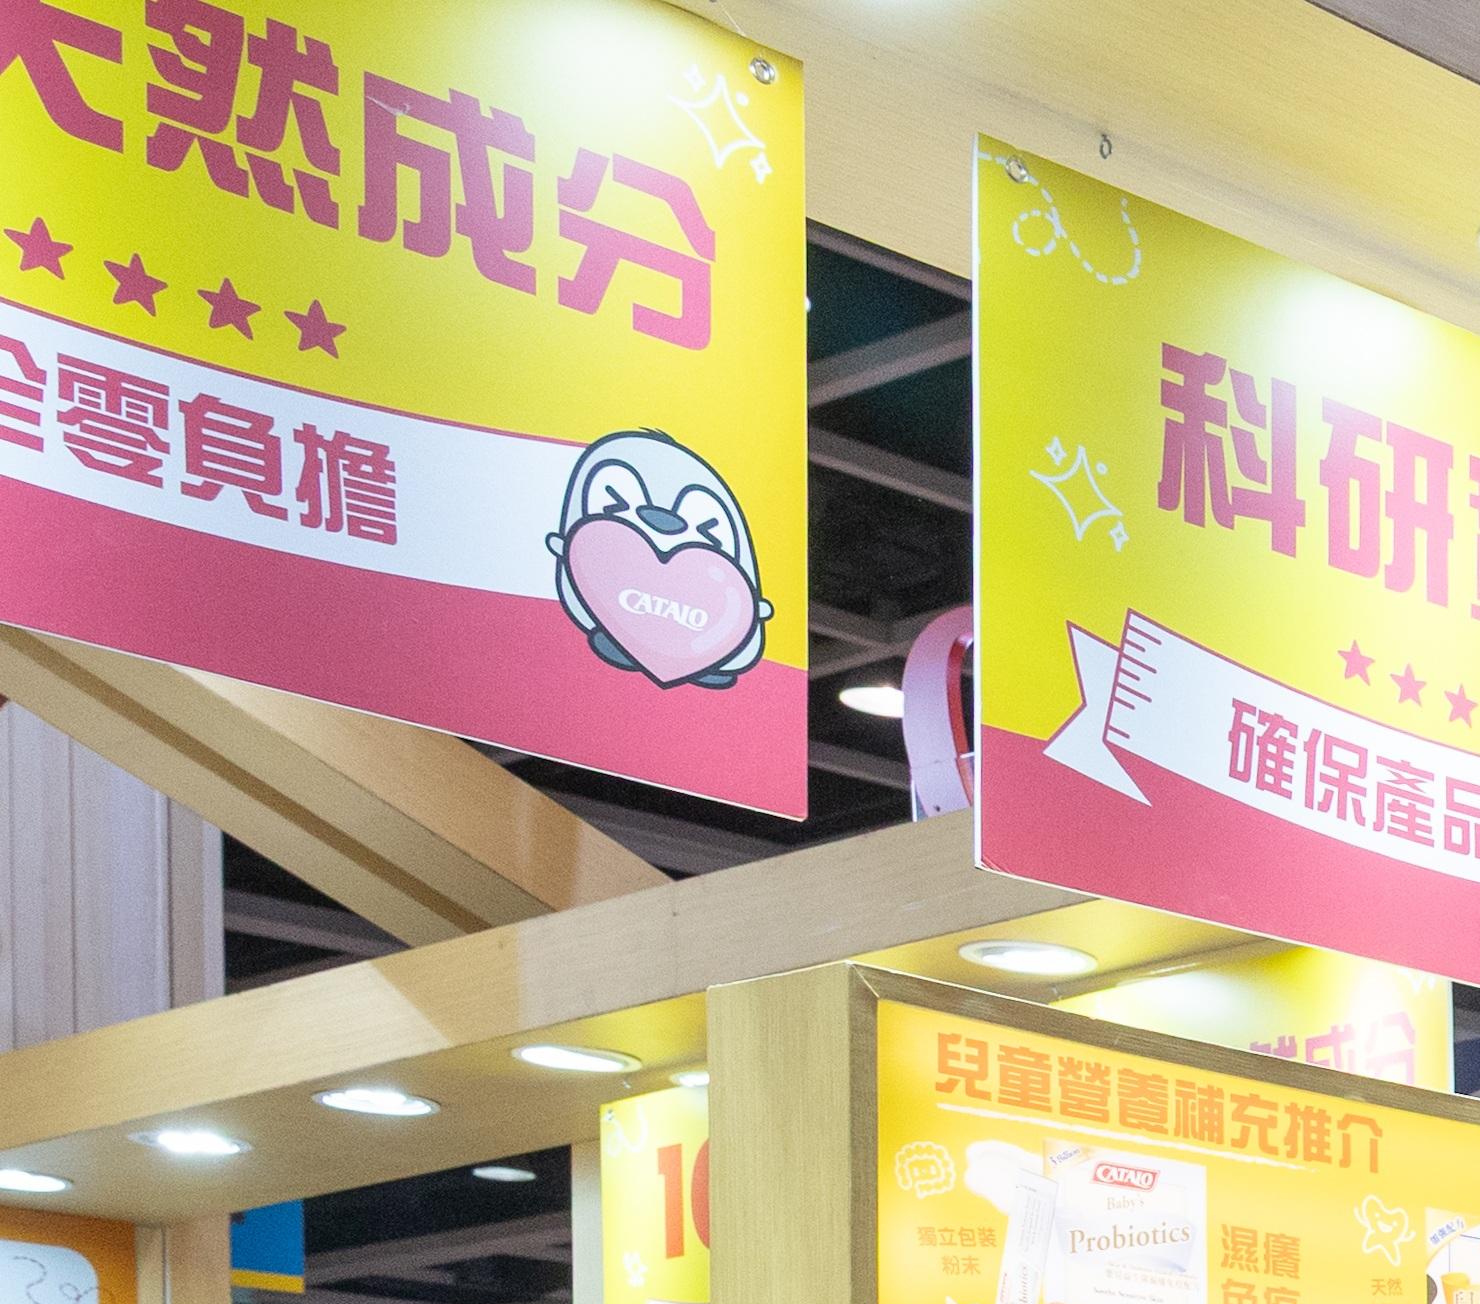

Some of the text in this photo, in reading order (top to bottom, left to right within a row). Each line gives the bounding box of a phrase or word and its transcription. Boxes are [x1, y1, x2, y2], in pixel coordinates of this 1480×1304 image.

[617, 587, 710, 632] CATALO
[937, 1031, 1384, 1175] 兒童營養補充推介
[1096, 1165, 1157, 1190] CATALO
[1106, 1195, 1145, 1211] Baby's
[918, 1226, 997, 1248] 獨立包裝
[1069, 1222, 1190, 1254] Probiotics
[1221, 1222, 1301, 1280] 濕癢
[941, 1256, 981, 1276] 粉末
[1371, 1278, 1403, 1296] 天然
